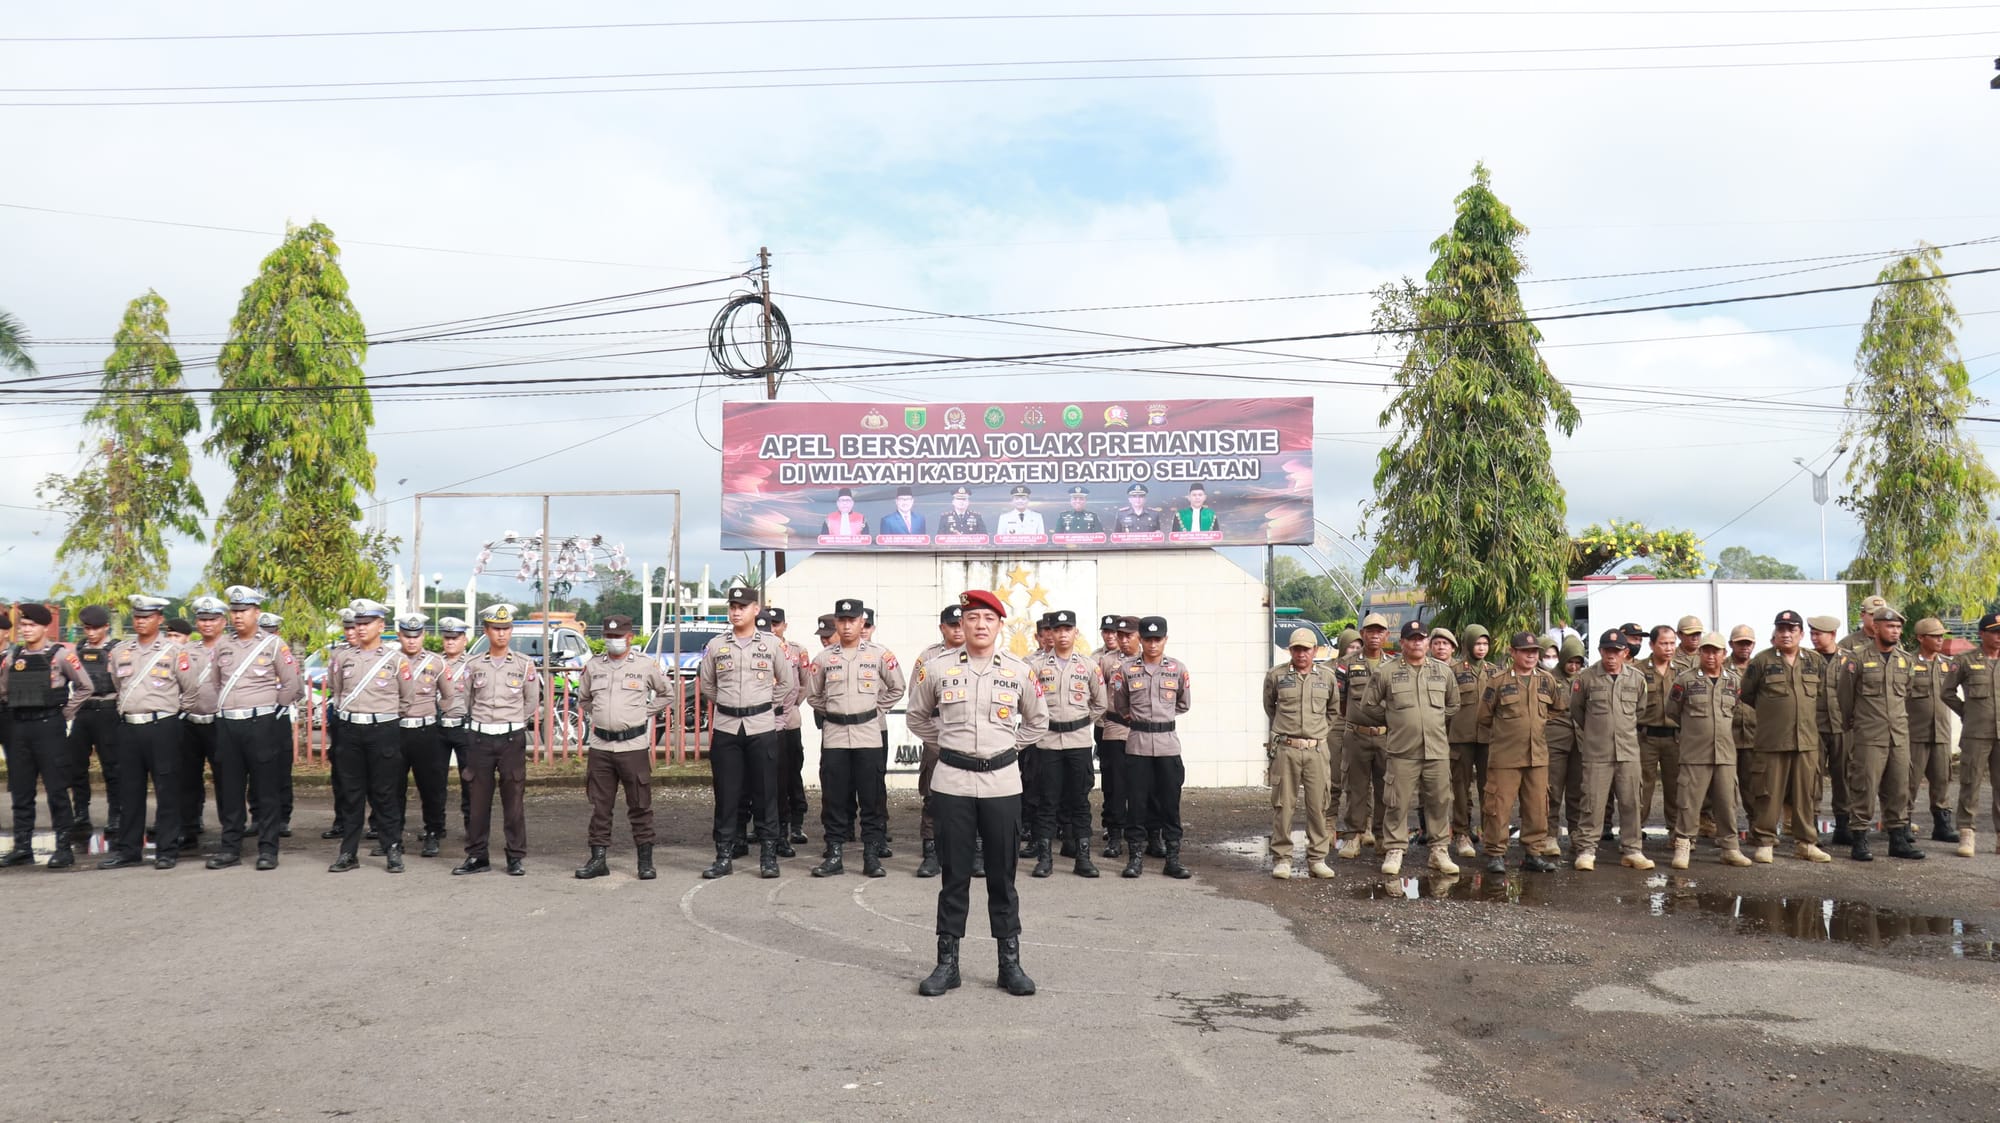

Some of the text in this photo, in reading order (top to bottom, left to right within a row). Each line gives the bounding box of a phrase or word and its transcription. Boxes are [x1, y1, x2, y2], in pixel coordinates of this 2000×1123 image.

[759, 430, 1280, 459] APEL BERSAMA TOLAK PREMANISME
[780, 458, 1261, 485] DI WILAYAH KABUPATEN BARITO SELATAN
[993, 679, 1019, 690] POLRI
